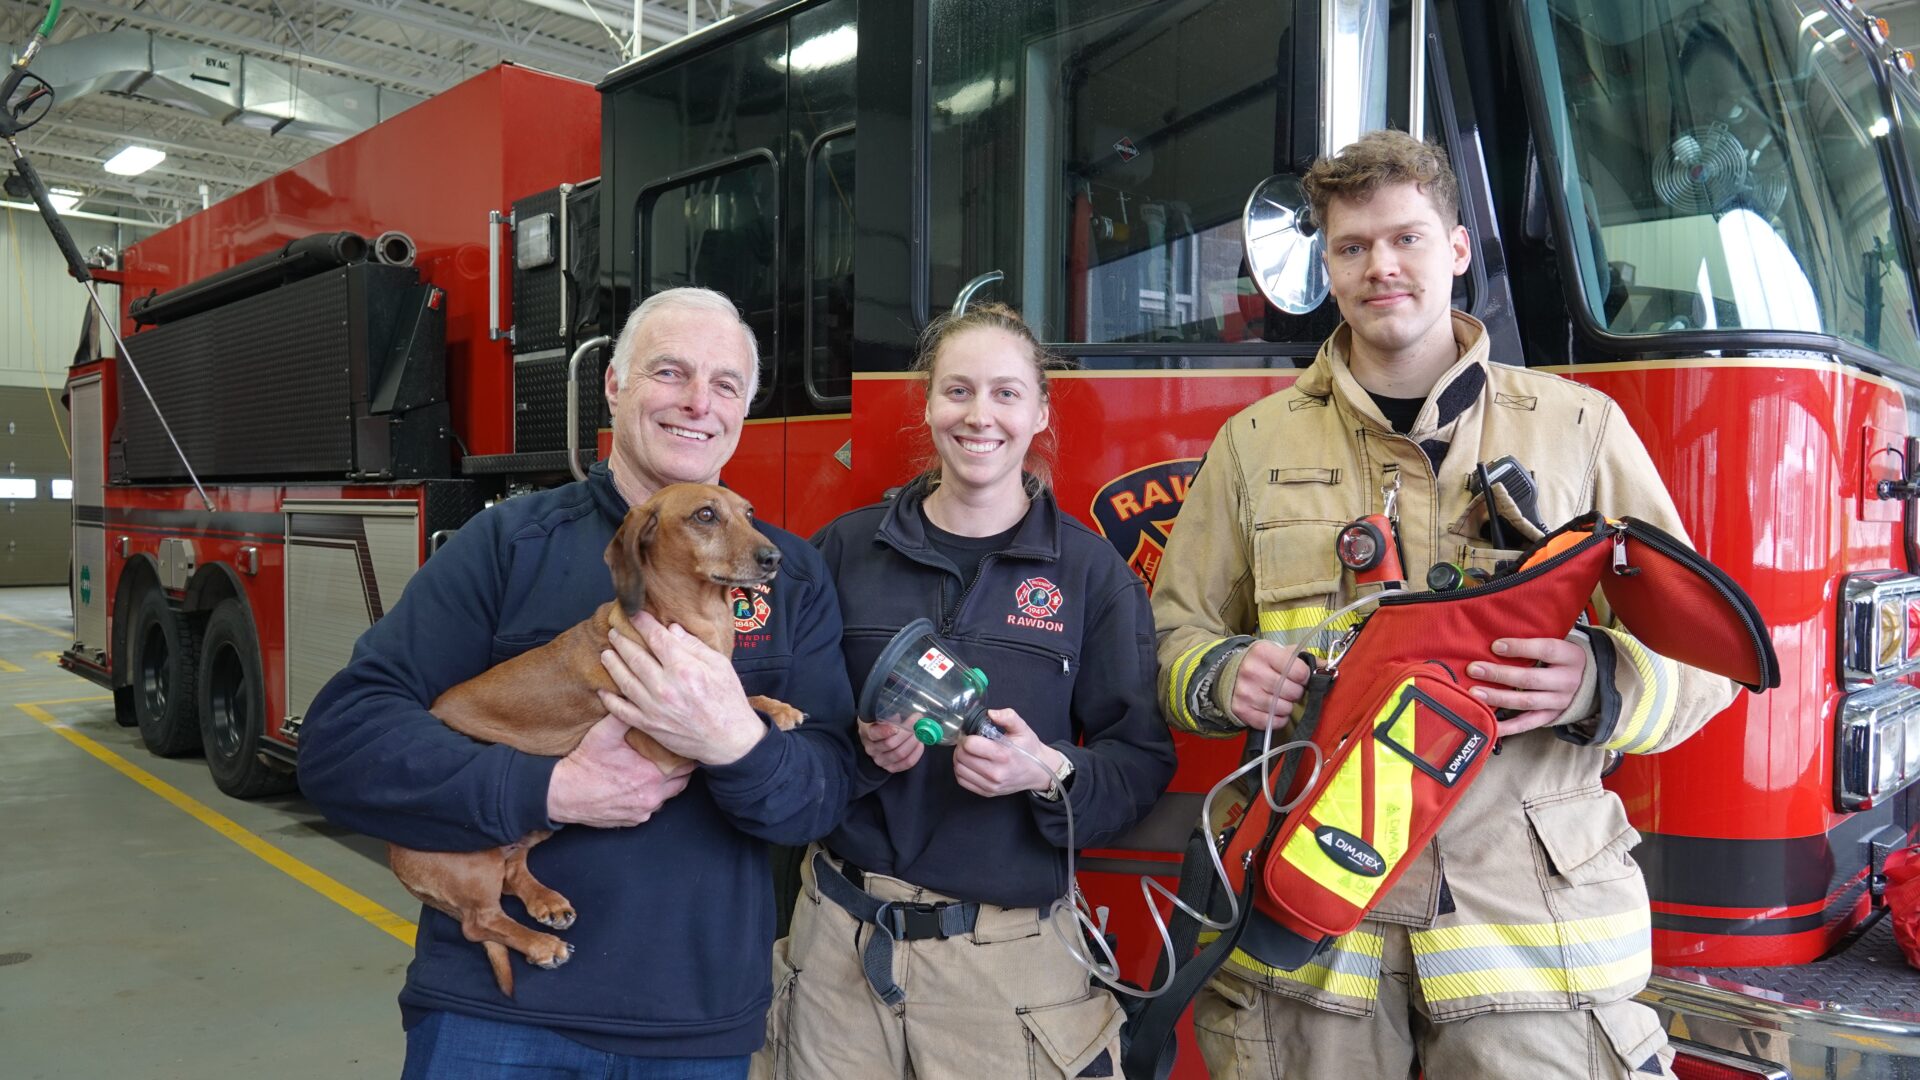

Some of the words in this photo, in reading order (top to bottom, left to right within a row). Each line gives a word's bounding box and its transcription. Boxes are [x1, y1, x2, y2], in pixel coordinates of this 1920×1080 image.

[1007, 614, 1064, 632] RAWDON
[1449, 734, 1481, 771] DIMATEX
[1335, 838, 1381, 870] DIMATEX
